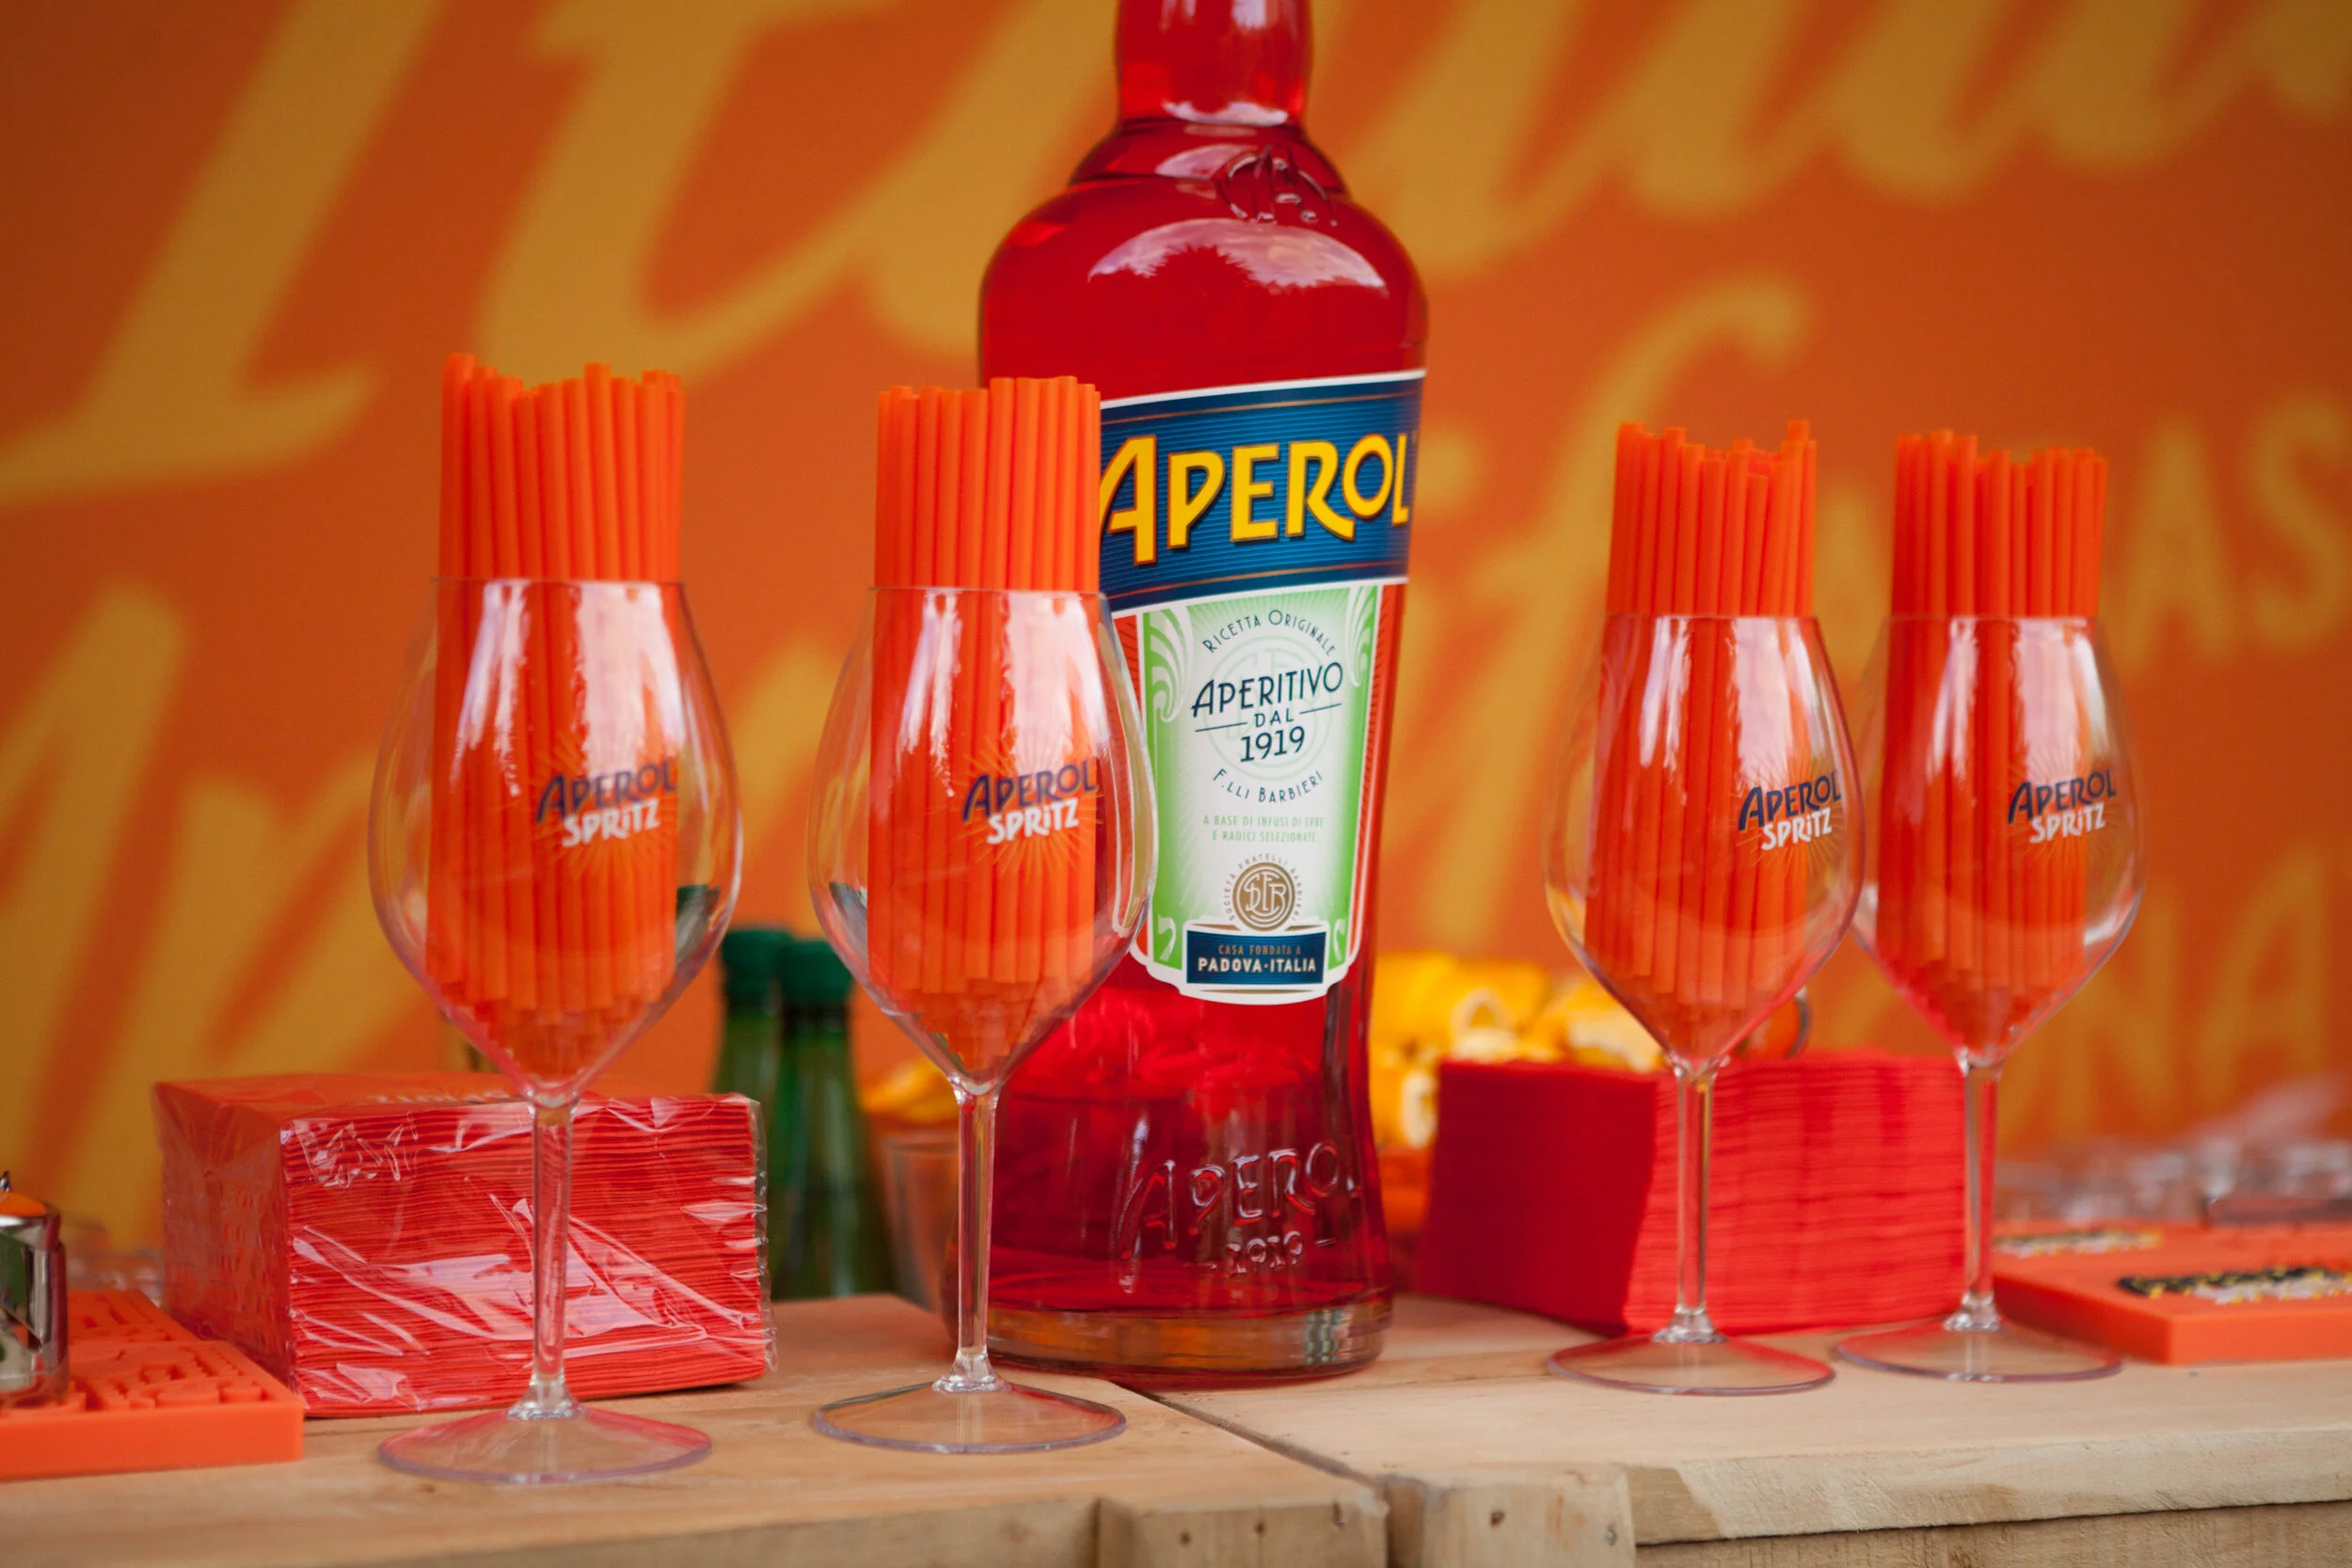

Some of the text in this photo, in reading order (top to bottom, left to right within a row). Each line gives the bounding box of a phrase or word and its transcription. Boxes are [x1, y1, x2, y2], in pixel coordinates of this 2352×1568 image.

[1099, 433, 1409, 566] APEROL
[1202, 610, 1337, 657] RICETTA ORIGINALE
[1190, 662, 1343, 718] APERITIVO
[1254, 708, 1295, 729] DAL
[1240, 726, 1305, 763] 1919
[534, 759, 677, 826] APEROL
[961, 760, 1099, 823] APEROL
[1259, 770, 1323, 803] BARBIERI
[1738, 770, 1841, 832] APEROL
[2008, 768, 2116, 824] APEROL
[1203, 815, 1210, 826] A
[1214, 815, 1238, 826] BASE
[1243, 816, 1253, 826] DI
[1257, 816, 1289, 828] INFUSI
[1292, 816, 1302, 828] DI
[1212, 831, 1317, 842] E RADICI SELEZIONATE
[1218, 944, 1301, 955] CASA FONDATA A
